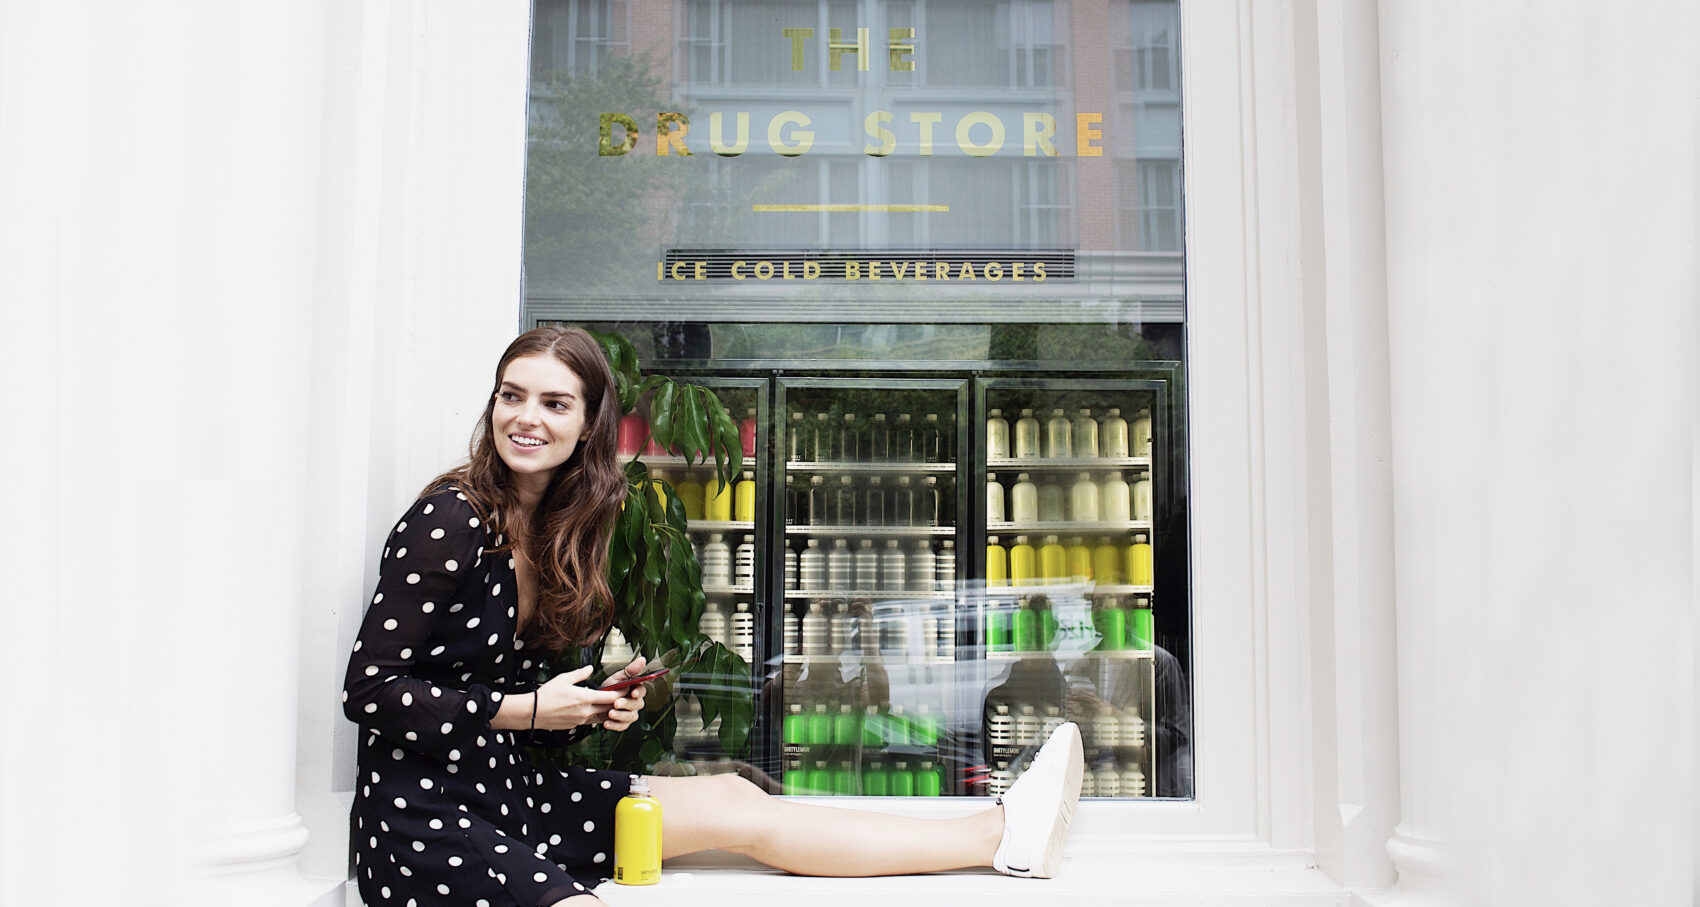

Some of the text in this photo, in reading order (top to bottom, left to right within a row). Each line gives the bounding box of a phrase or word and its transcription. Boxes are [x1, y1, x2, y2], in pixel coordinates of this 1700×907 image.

[783, 27, 916, 72] THE
[599, 110, 1104, 158] DRUG STORE
[657, 260, 1048, 281] ICE COLD BEVERAGES
